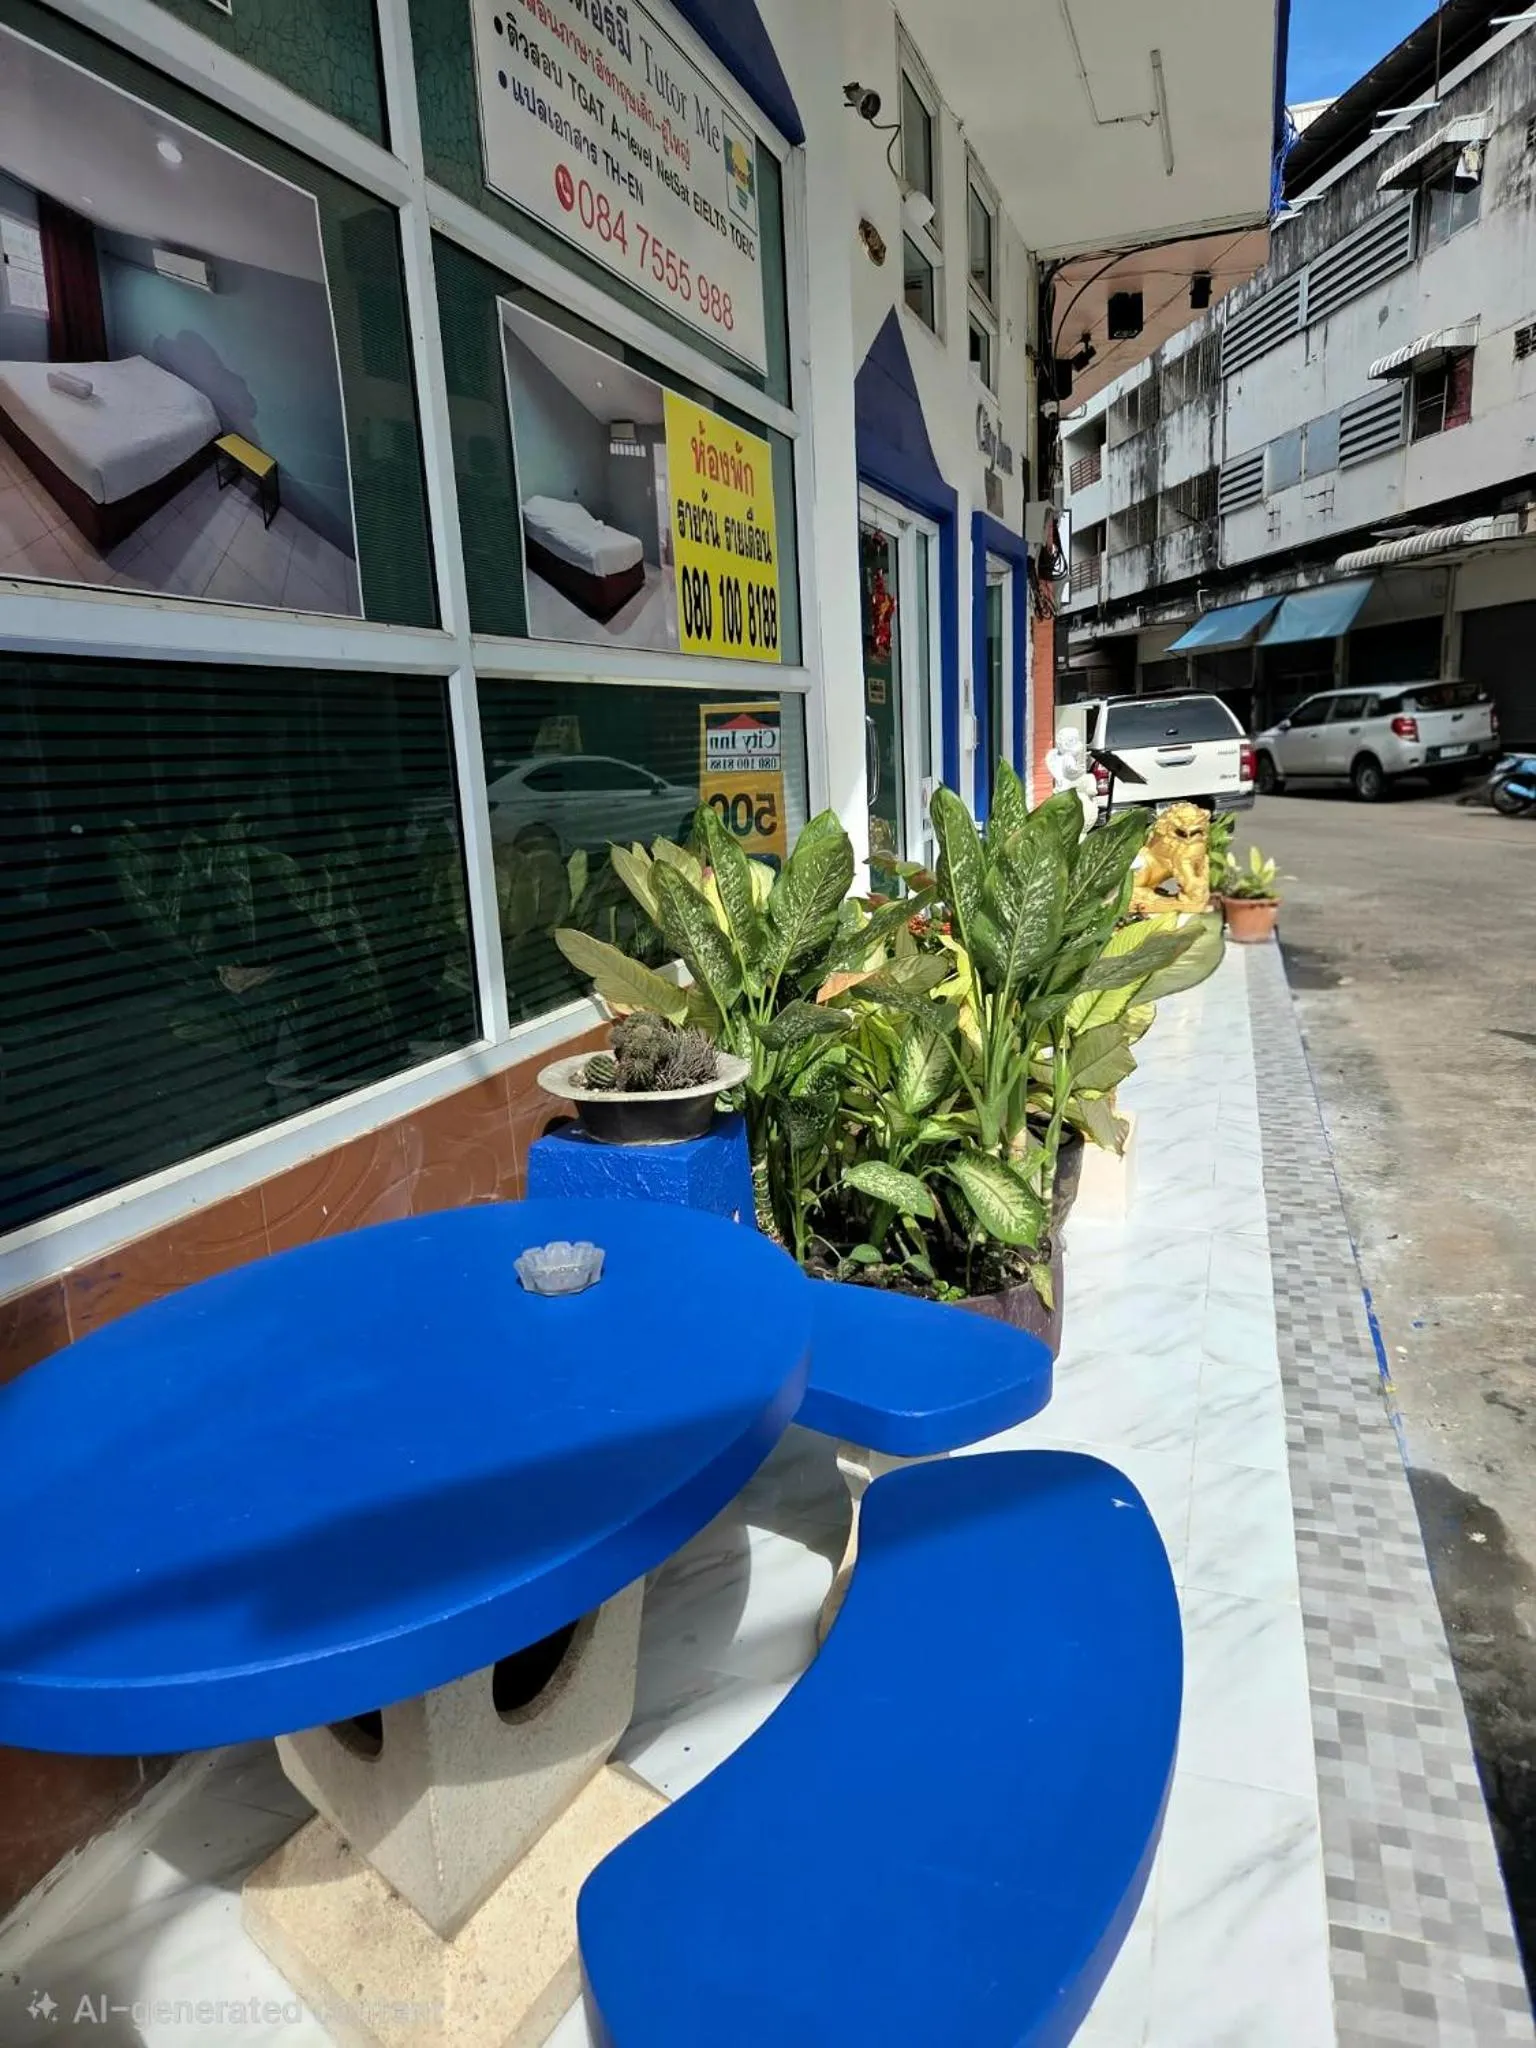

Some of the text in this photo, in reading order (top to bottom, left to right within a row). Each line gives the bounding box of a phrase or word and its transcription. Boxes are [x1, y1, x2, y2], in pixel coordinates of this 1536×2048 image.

[506, 12, 563, 89] ติวสอบ
[567, 72, 604, 126] TGAT
[611, 113, 653, 172] A-level
[656, 154, 691, 208] NetSat
[729, 222, 755, 261] TOEIC
[512, 76, 644, 206] แปลเอกสาร TH-EN
[638, 34, 688, 121] Tutor
[694, 92, 721, 153] Me
[578, 179, 735, 331] 084 7555 988
[691, 420, 755, 497] ห้องพัก
[677, 489, 772, 565] รายวัน รายเดือน
[682, 565, 777, 650] 080 100 8188
